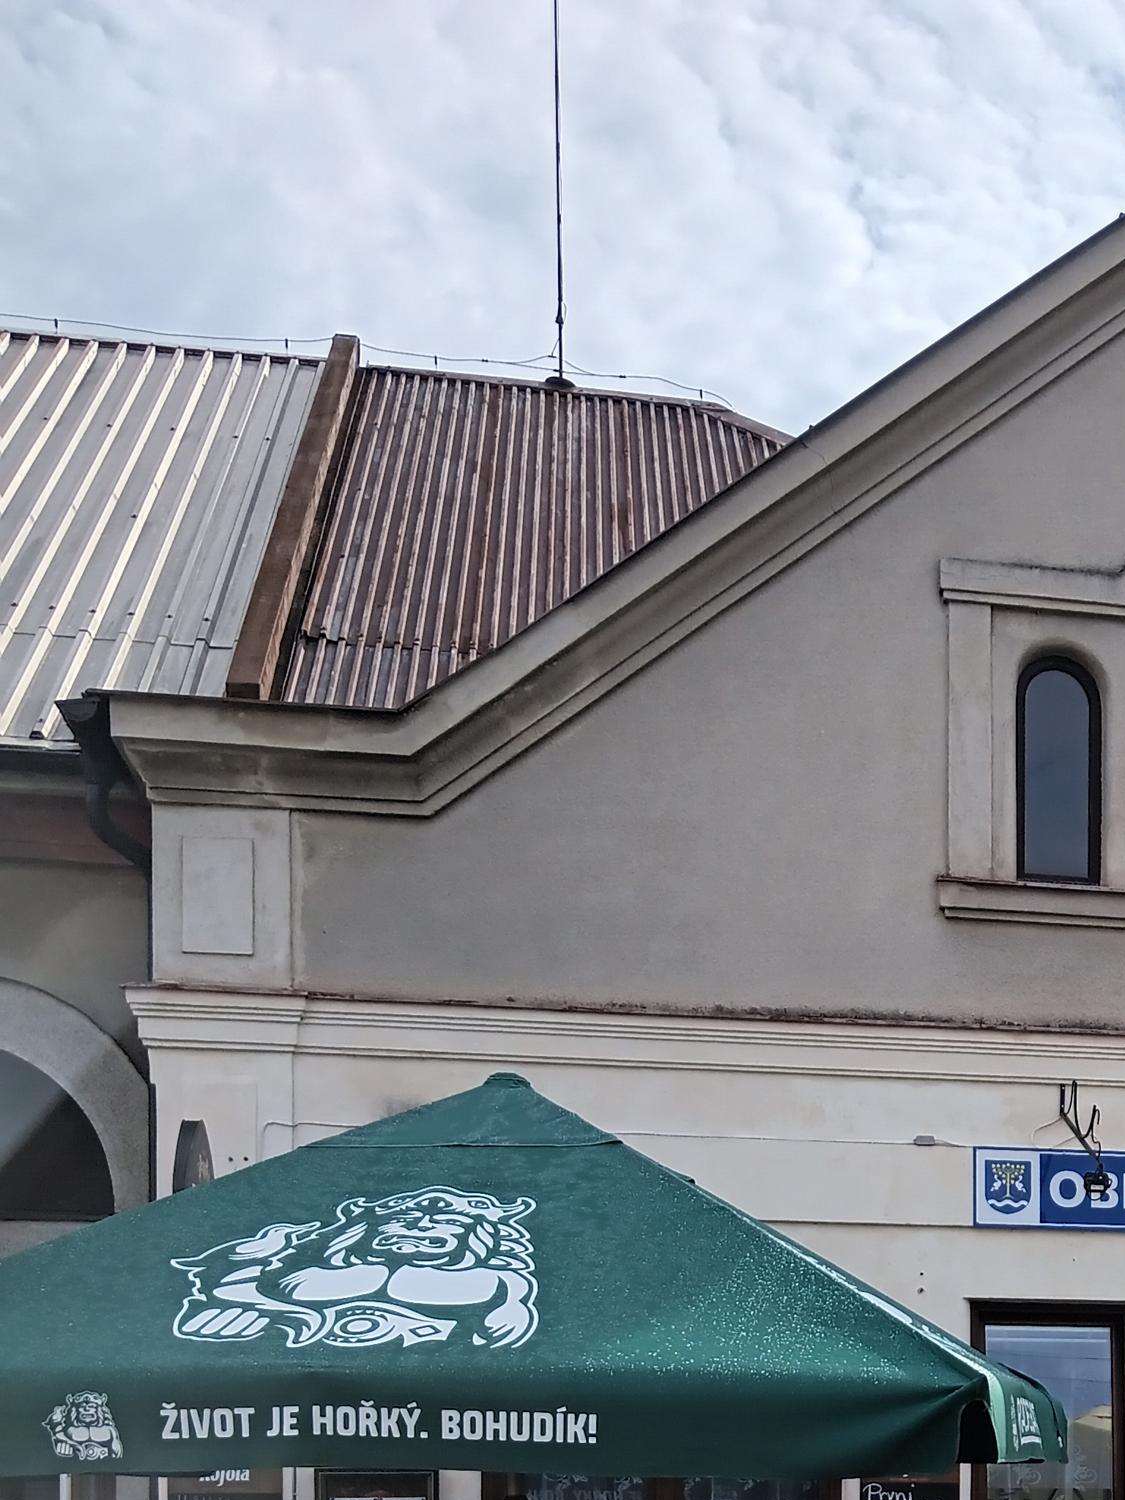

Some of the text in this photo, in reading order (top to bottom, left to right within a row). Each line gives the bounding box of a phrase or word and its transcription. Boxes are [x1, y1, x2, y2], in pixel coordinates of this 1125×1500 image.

[159, 1400, 598, 1444] ŽIVOT JE HOŘKÝ. BOHUDÍK!
